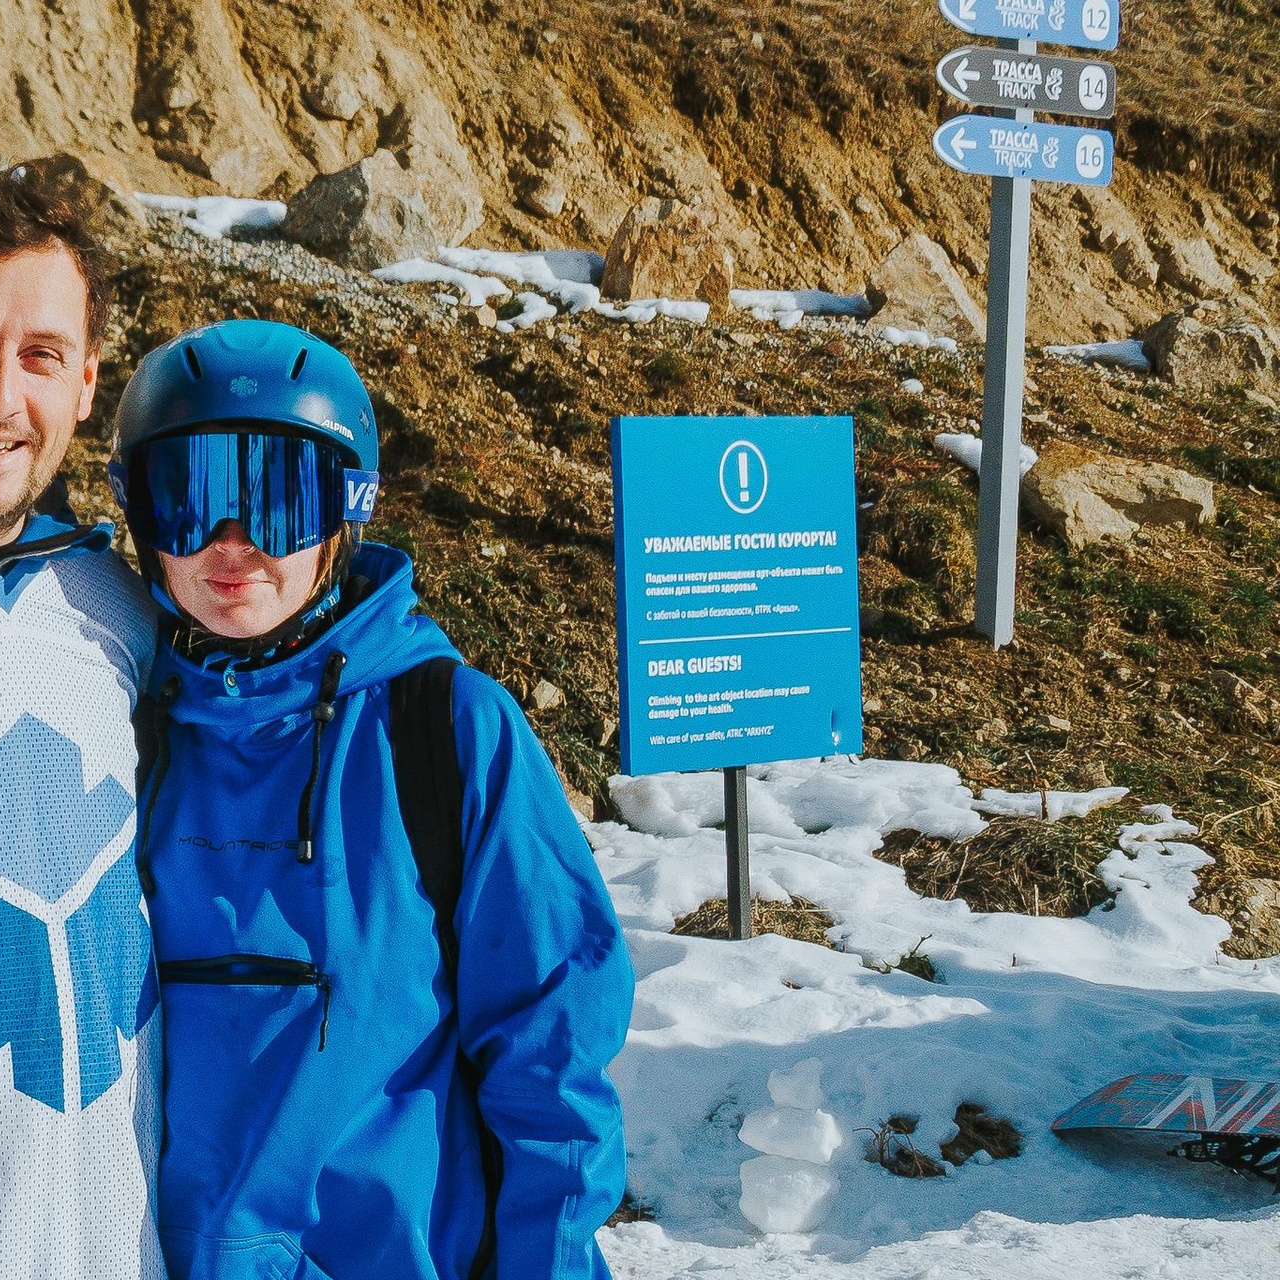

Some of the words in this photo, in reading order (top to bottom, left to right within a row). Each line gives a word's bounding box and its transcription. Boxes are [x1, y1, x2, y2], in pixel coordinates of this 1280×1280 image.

[1001, 9, 1039, 31] TRACK
[1086, 8, 1109, 31] 12
[997, 79, 1037, 101] TRACK
[1083, 77, 1105, 100] 14
[994, 149, 1033, 170] TRACK
[1080, 145, 1102, 167] 16
[644, 535, 732, 554] УВАЖАЕМЫЕ
[734, 533, 776, 550] ГОСТИ
[778, 530, 837, 548] КУРОРТА!
[648, 659, 685, 677] DEAR
[687, 655, 742, 674] GUESTS!
[648, 695, 682, 706] Climbing
[685, 694, 694, 703] to
[694, 692, 708, 703] the
[708, 691, 721, 701] art
[720, 690, 744, 702] object
[744, 687, 773, 699] location
[774, 687, 789, 697] may
[790, 685, 810, 695] cause
[648, 709, 680, 720] damage
[680, 707, 689, 716] to
[690, 706, 708, 718] your
[649, 734, 666, 745] With
[666, 735, 681, 744] care
[681, 732, 689, 742] of
[690, 733, 704, 744] your
